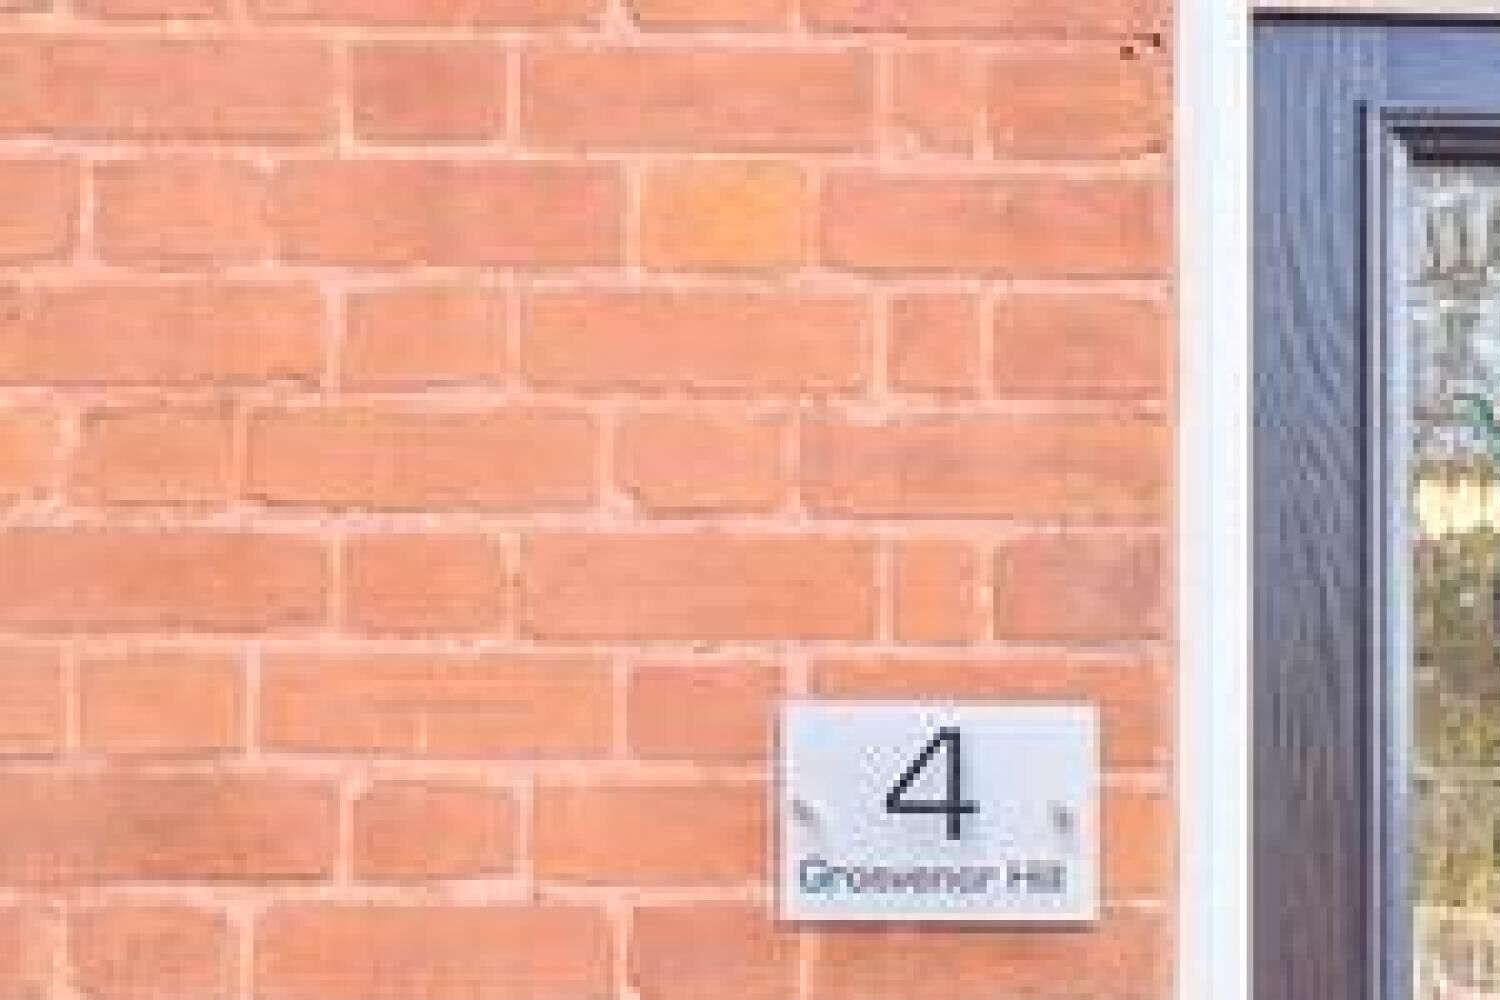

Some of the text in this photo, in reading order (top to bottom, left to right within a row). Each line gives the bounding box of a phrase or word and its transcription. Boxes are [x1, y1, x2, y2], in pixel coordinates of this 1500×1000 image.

[886, 726, 979, 840] 4
[799, 859, 1066, 894] Grosvenor Hill
